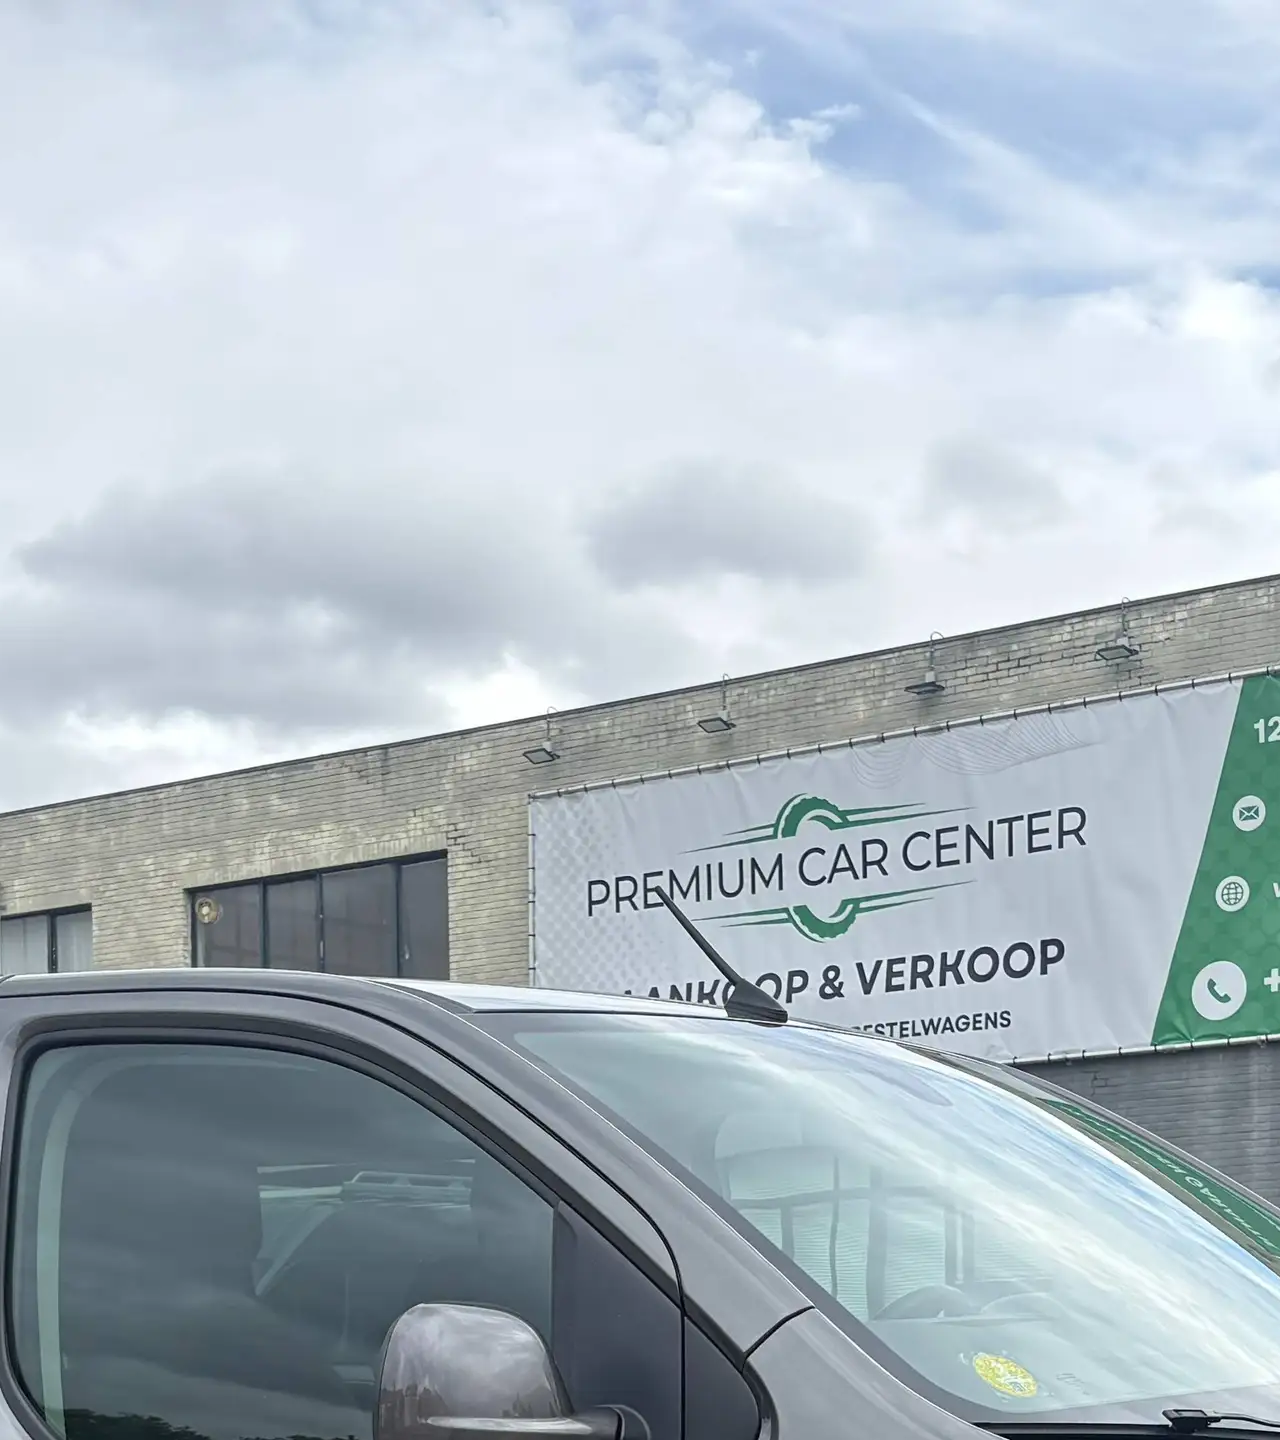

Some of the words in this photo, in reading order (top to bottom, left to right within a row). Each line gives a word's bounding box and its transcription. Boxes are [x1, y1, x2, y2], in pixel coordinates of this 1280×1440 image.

[587, 852, 784, 917] PREMIUM
[798, 838, 889, 886] CAR
[902, 806, 1088, 871] CENTER
[818, 965, 845, 1000] &
[855, 938, 1066, 996] VERKOOP
[851, 1010, 1012, 1040] STELWAGENS
